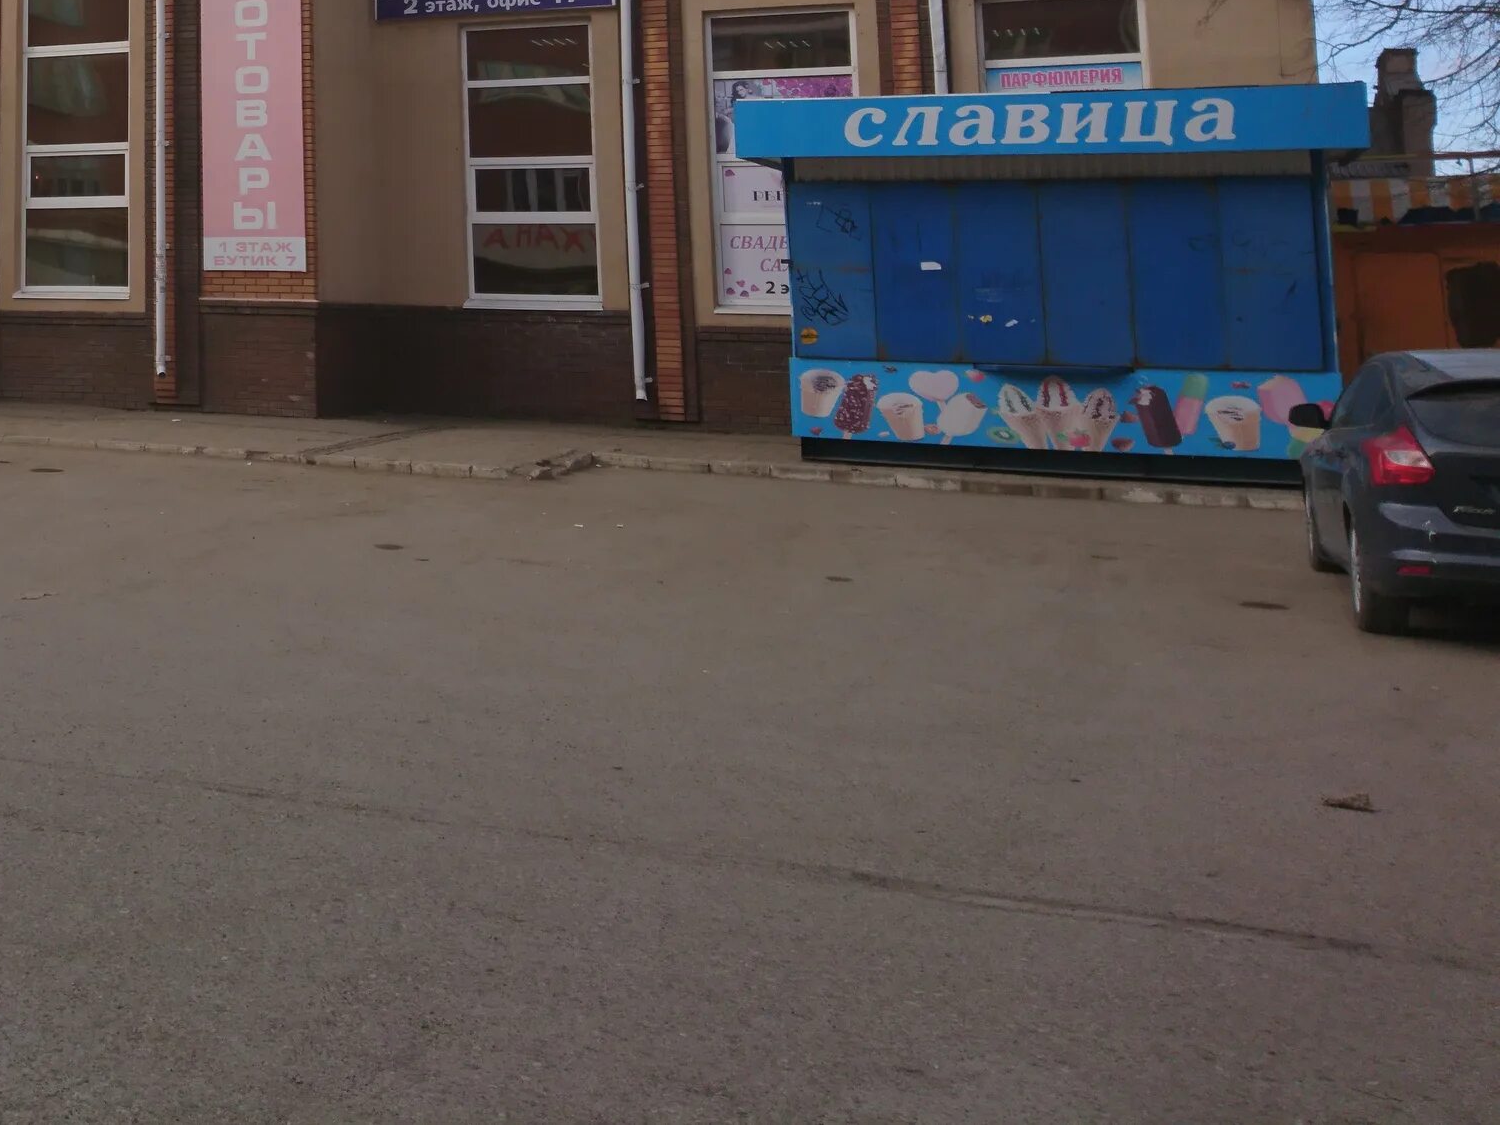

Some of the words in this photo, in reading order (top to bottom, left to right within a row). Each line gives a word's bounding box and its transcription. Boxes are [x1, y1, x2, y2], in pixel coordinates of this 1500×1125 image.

[1000, 67, 1123, 89] ПАРФЮМЕРИЯ
[844, 97, 1237, 149] славица
[235, 242, 293, 253] ЭТАЖ
[213, 255, 277, 266] БУТИК
[286, 255, 297, 266] 7
[765, 281, 776, 294] 2
